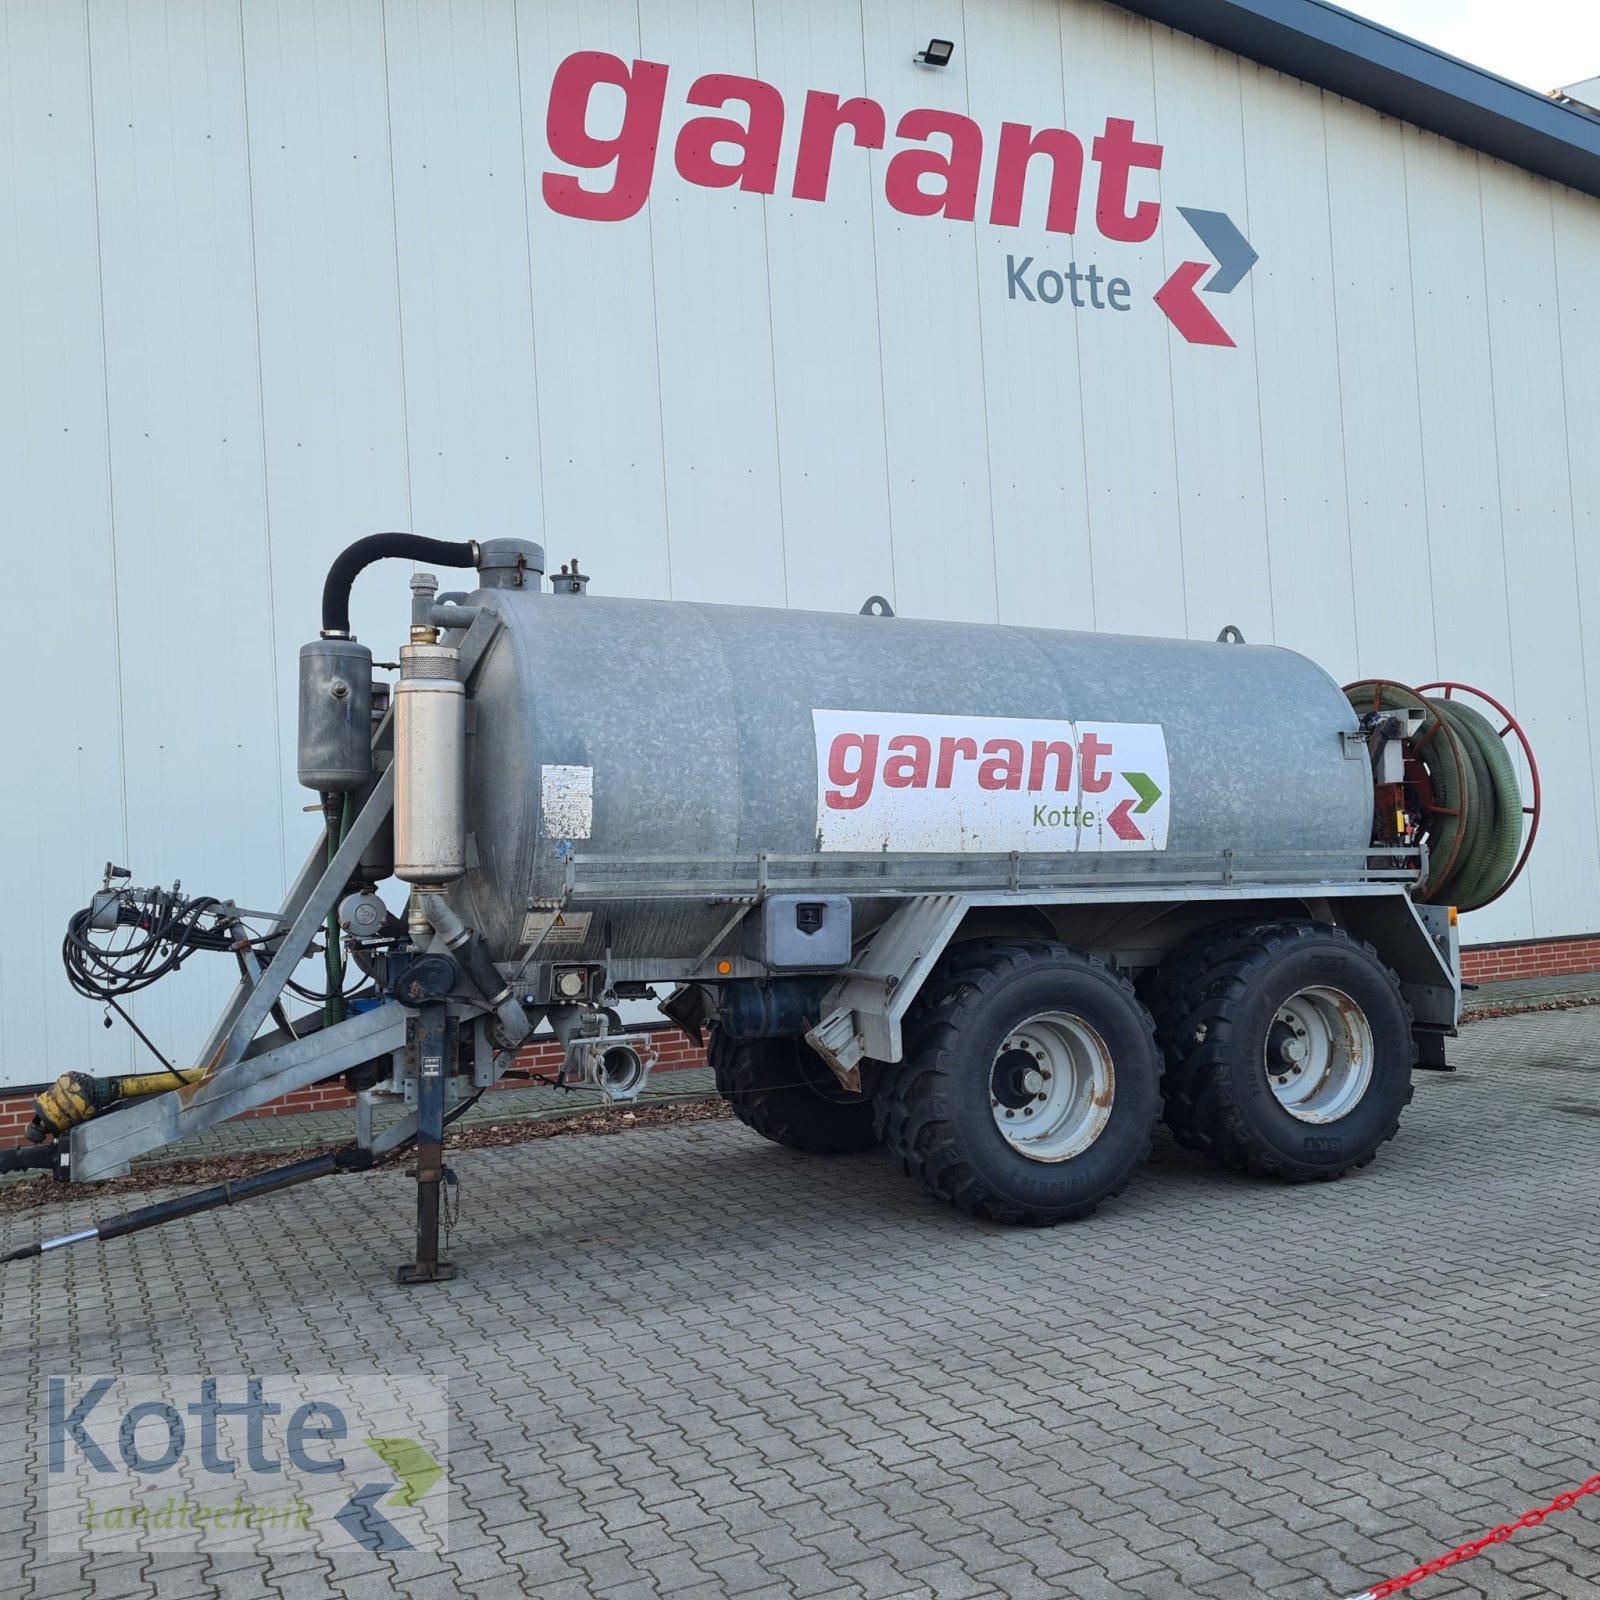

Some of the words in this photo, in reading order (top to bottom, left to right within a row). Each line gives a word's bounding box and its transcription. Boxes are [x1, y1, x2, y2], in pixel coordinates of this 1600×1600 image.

[541, 50, 1163, 243] garant
[1006, 254, 1131, 312] Kotte
[825, 733, 1113, 810] garant
[1033, 805, 1095, 828] Kotte
[1303, 1136, 1342, 1154] BKT
